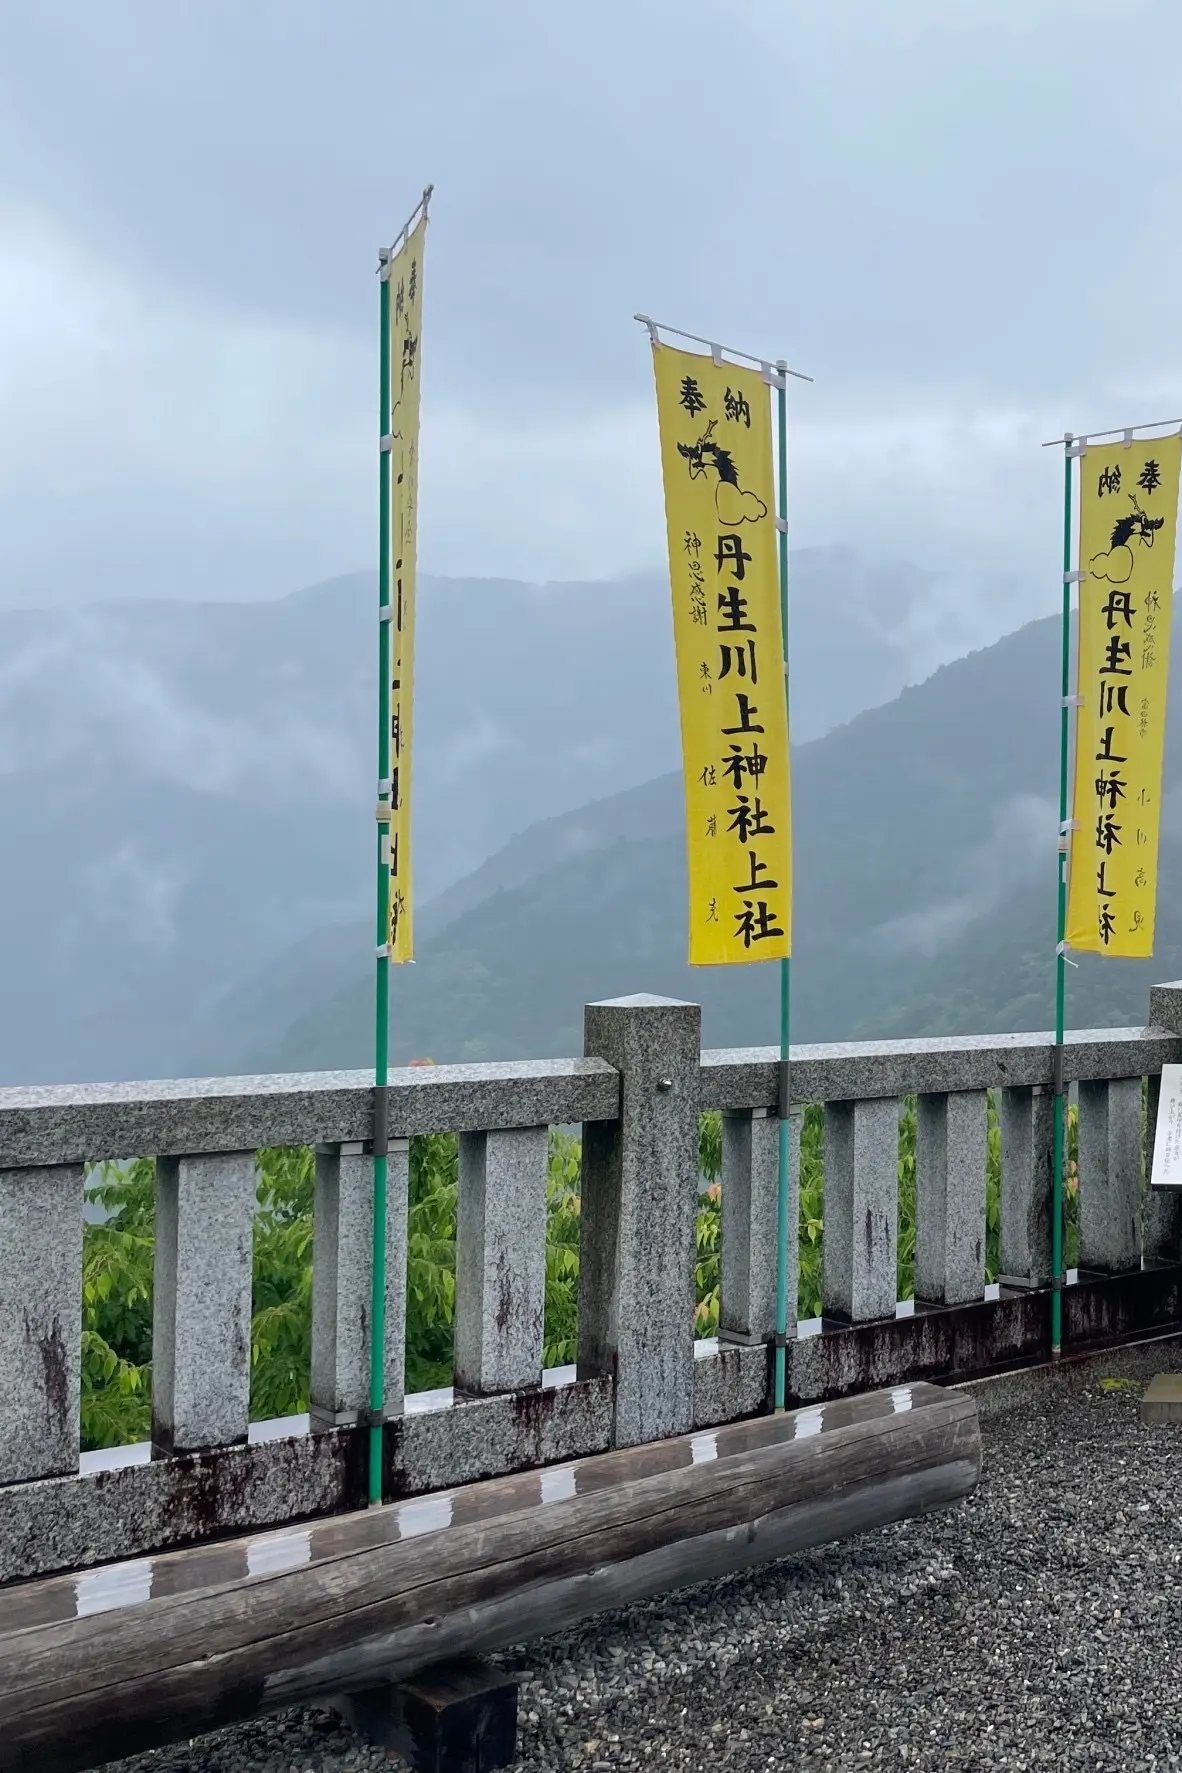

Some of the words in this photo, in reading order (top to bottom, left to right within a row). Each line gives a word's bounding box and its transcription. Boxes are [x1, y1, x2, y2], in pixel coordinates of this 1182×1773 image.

[678, 375, 751, 429] 奉納
[713, 533, 785, 949] 丹生川上神社上社
